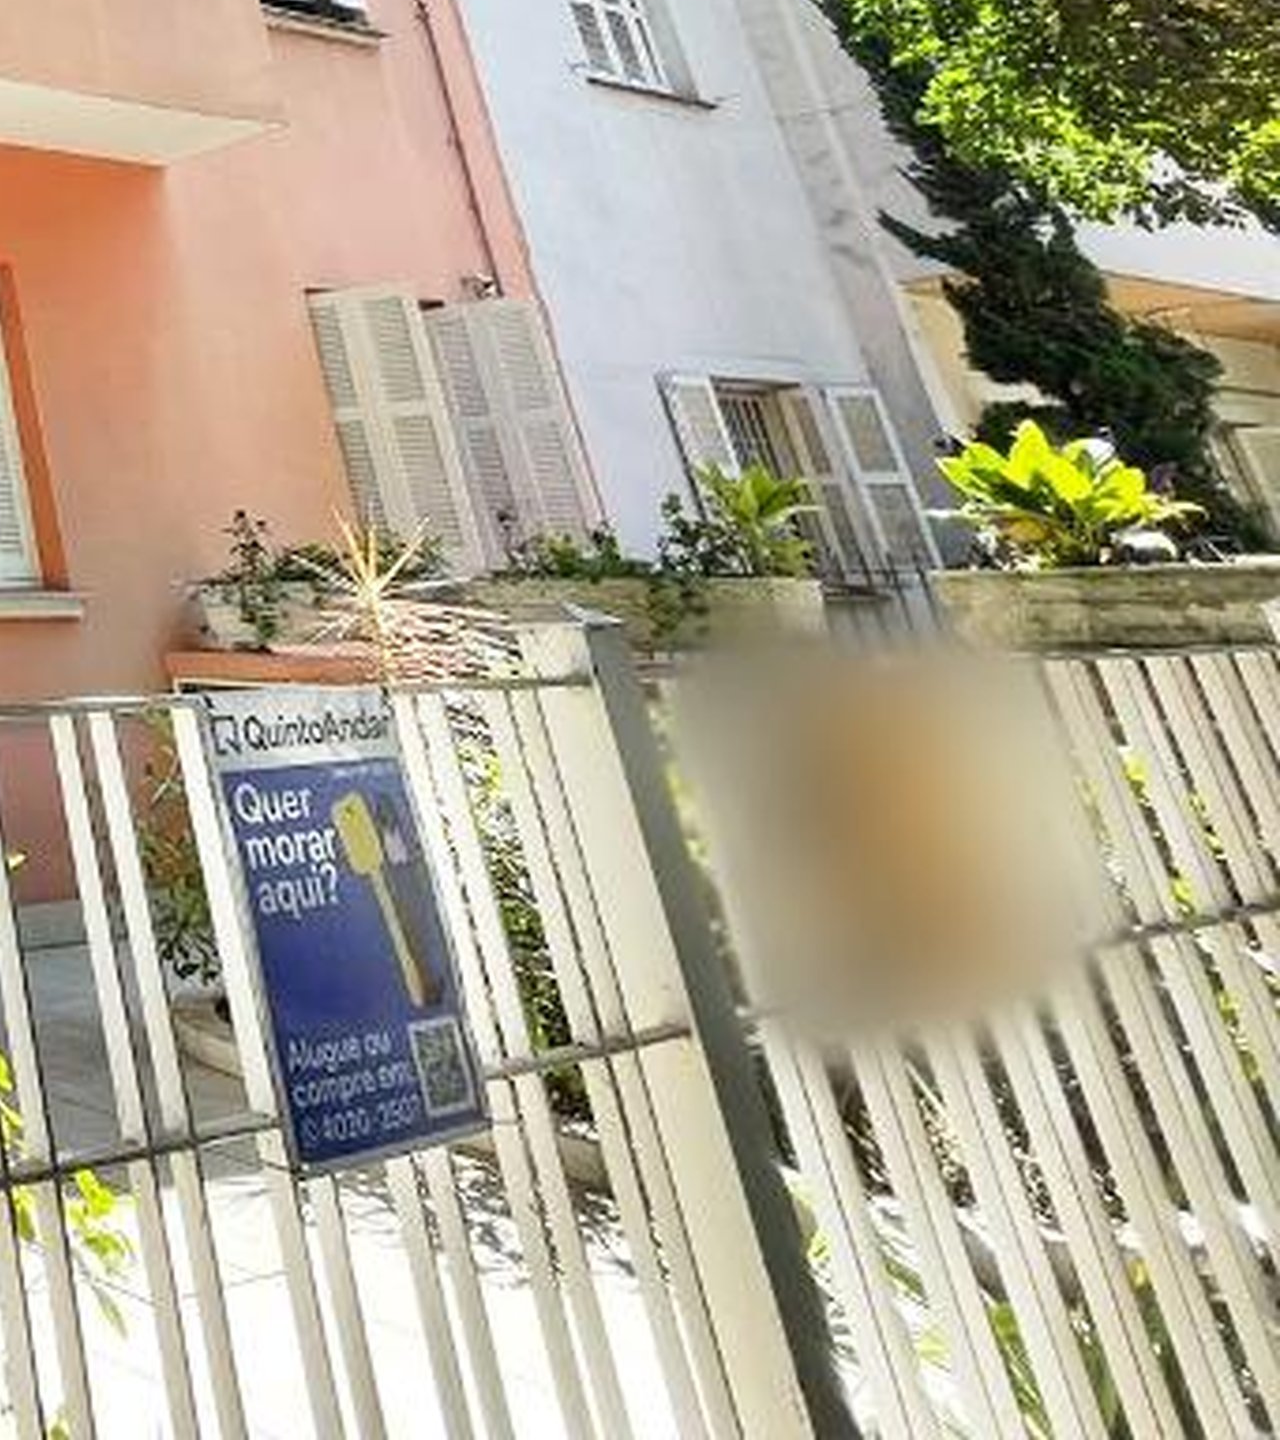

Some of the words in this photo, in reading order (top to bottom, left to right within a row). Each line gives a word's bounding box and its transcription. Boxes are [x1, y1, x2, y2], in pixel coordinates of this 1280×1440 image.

[243, 710, 390, 751] QuintoAndar
[234, 783, 312, 824] Quer
[246, 827, 337, 871] morar
[258, 864, 339, 920] aqui?
[293, 1070, 376, 1108] compre
